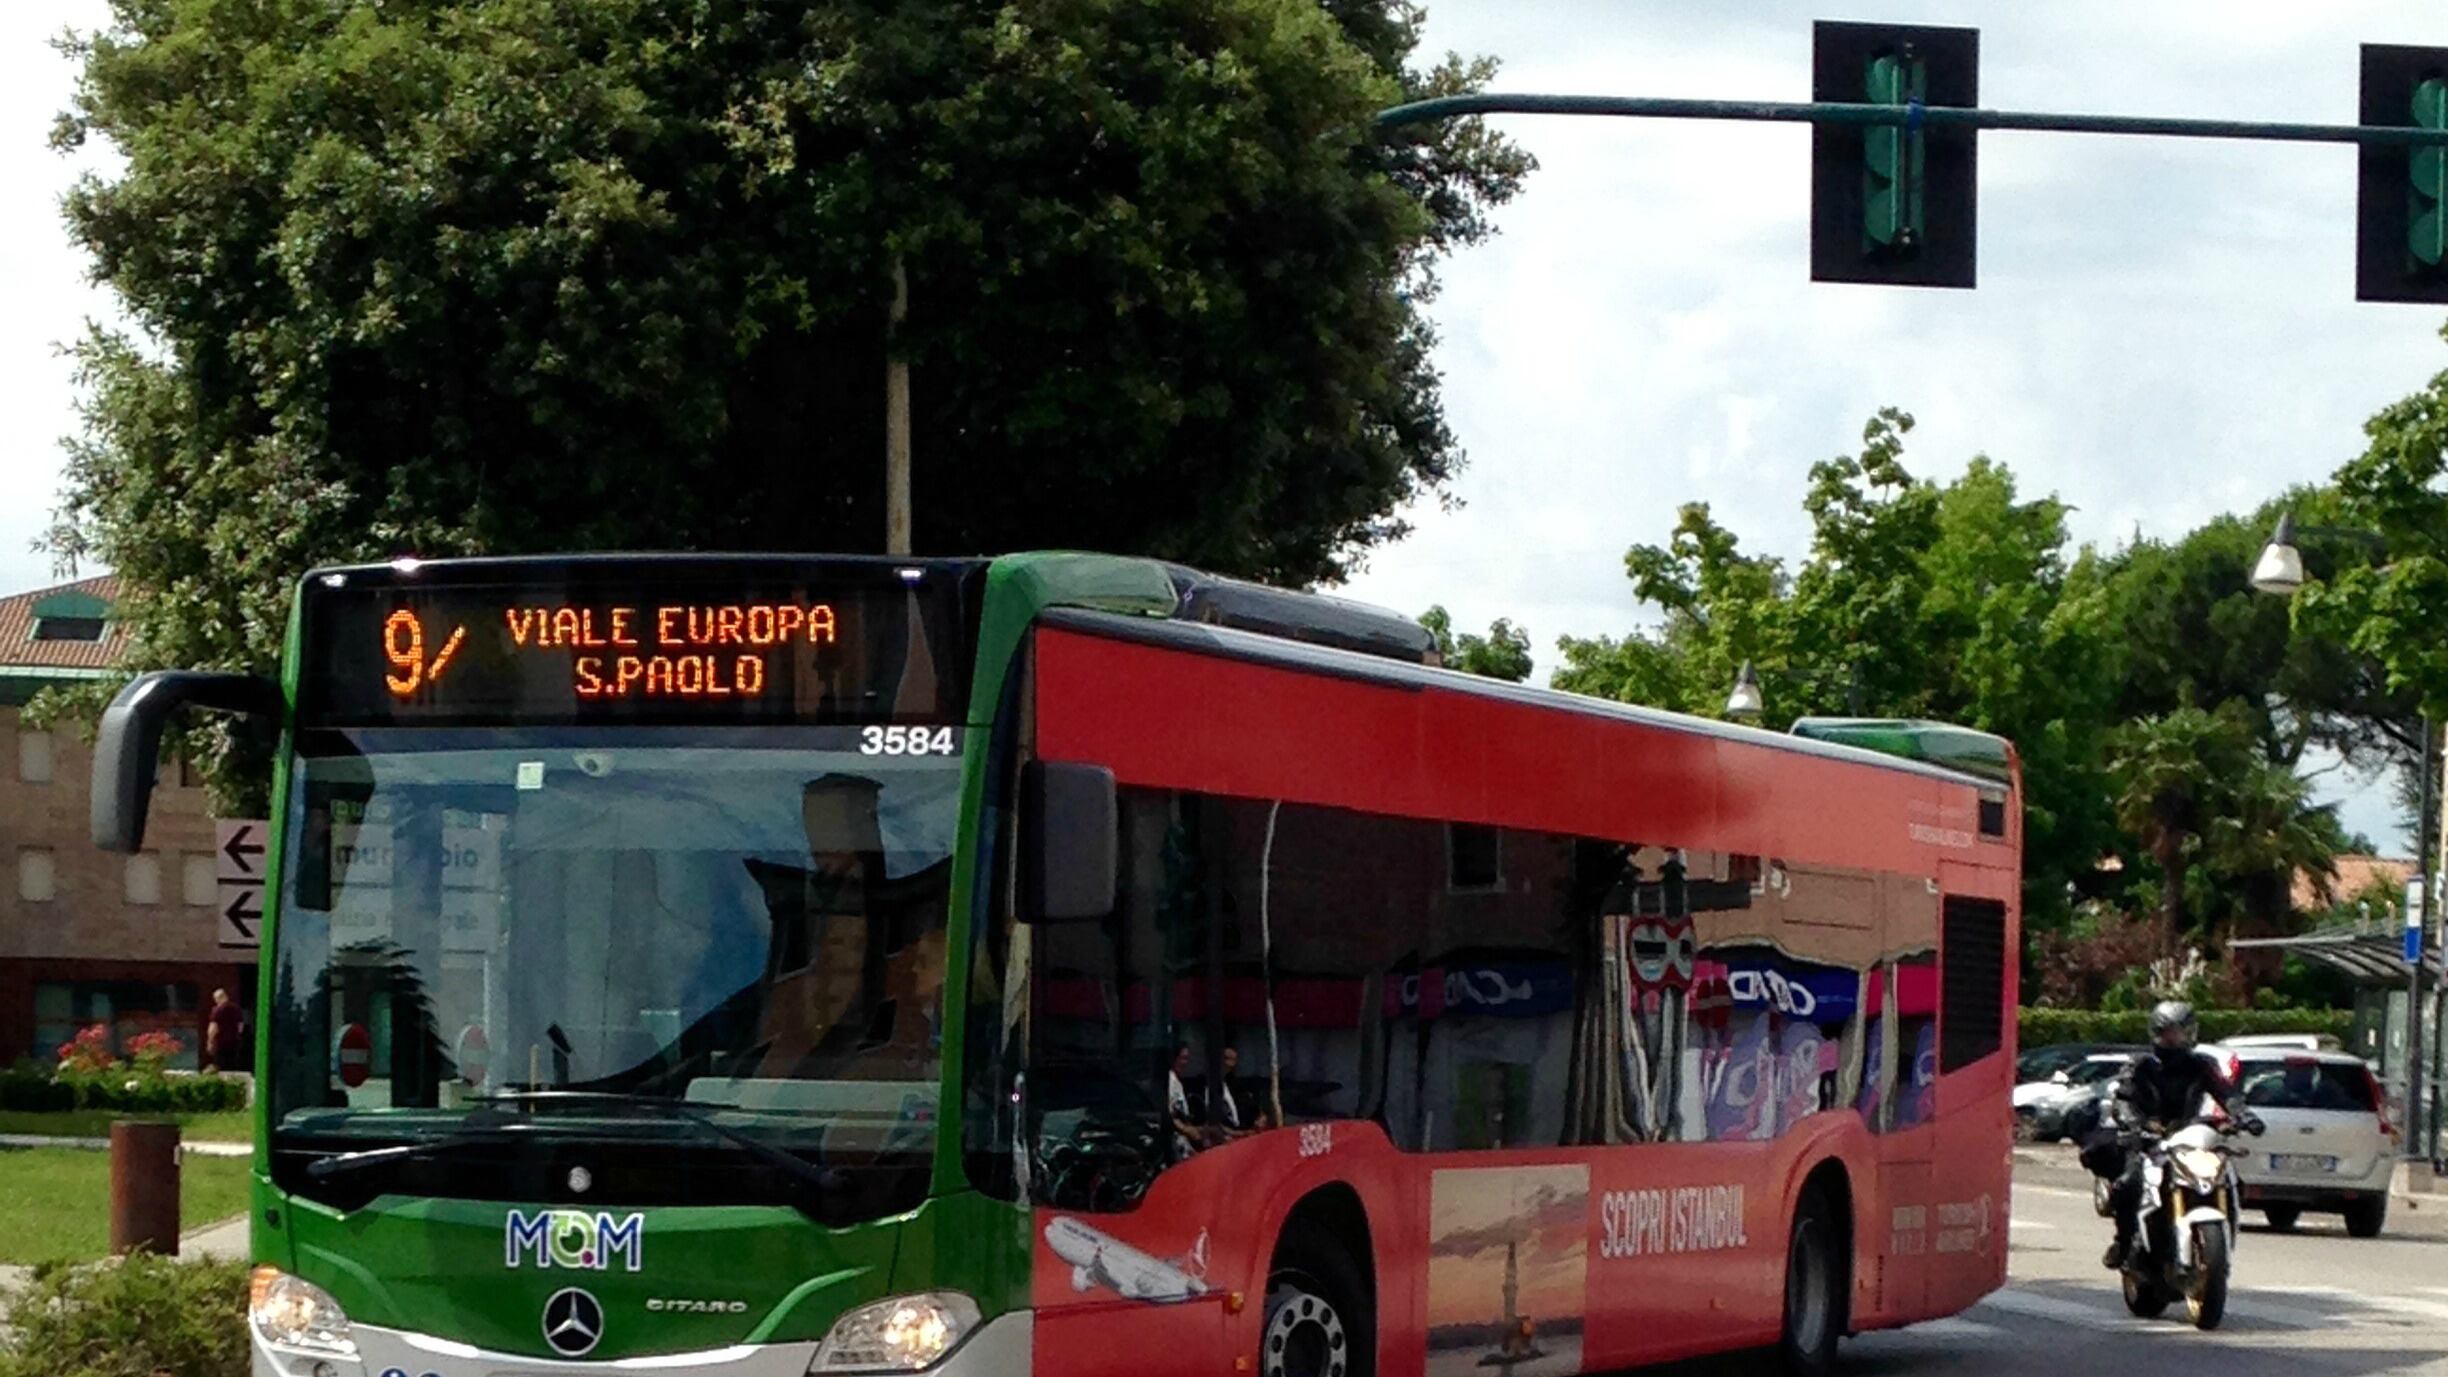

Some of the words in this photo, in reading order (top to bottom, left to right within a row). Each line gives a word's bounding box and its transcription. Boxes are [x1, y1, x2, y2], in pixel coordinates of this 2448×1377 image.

[506, 607, 637, 645] VIALE
[658, 604, 835, 645] EUROPA
[576, 655, 764, 694] S.PAOLO
[860, 726, 954, 755] 3584
[1600, 1189, 1667, 1259] SCOPRI
[1670, 1184, 1748, 1253] ISTANBUL
[645, 1298, 748, 1313] CITARO
